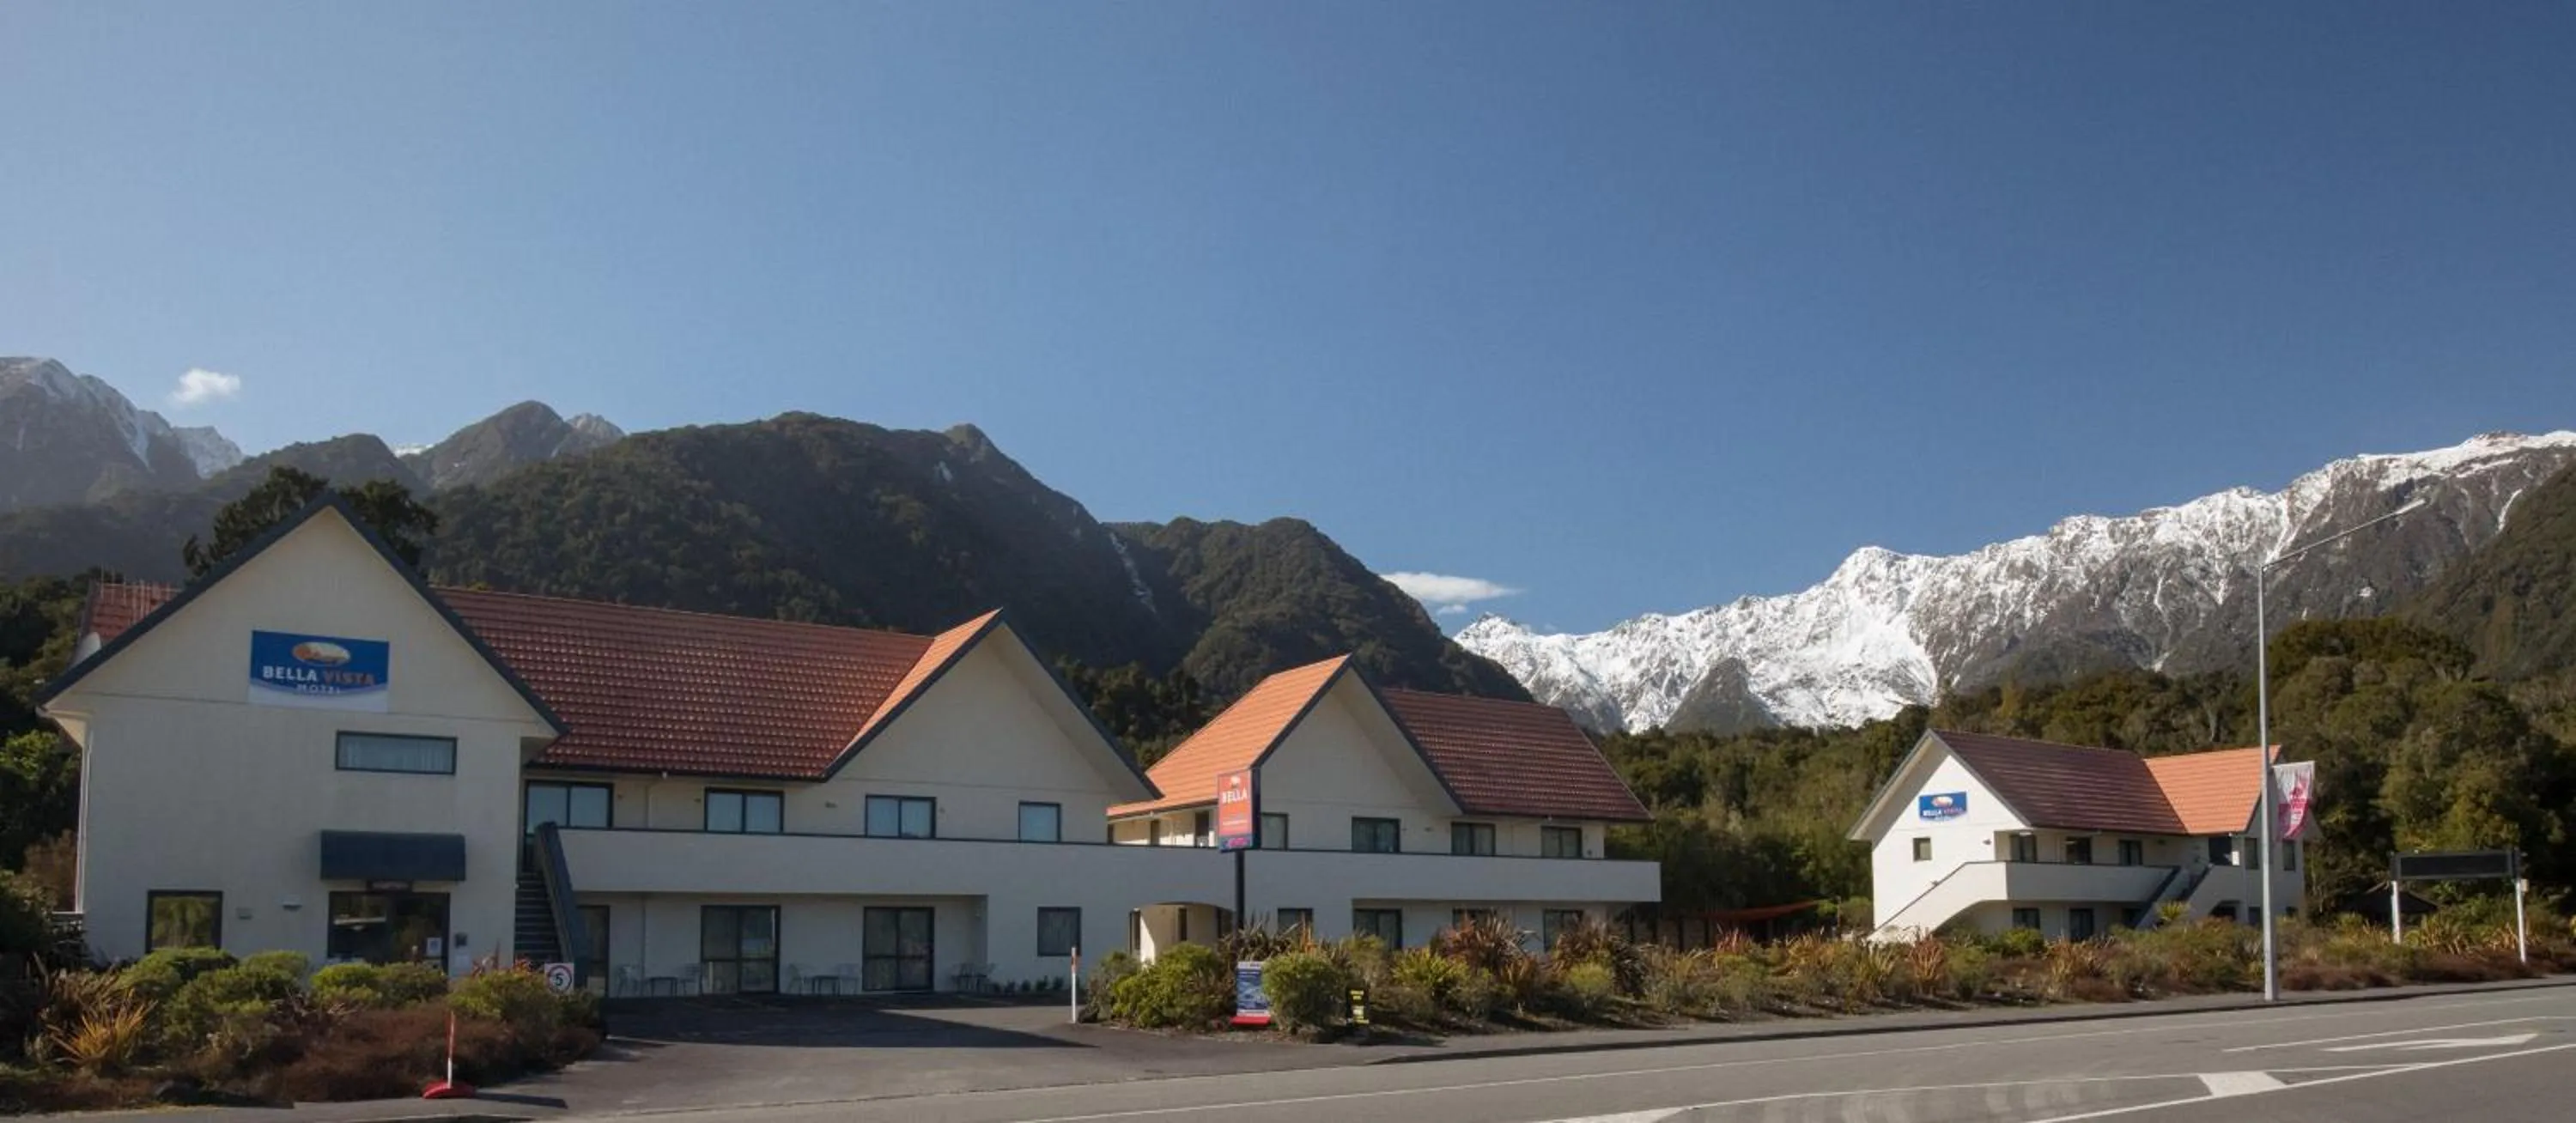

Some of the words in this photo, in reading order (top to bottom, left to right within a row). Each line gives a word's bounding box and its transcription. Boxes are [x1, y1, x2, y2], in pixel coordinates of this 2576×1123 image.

[262, 665, 318, 682] BELLA
[323, 670, 376, 686] VISTA
[1221, 787, 1249, 804] BELLA
[555, 972, 564, 986] 5
